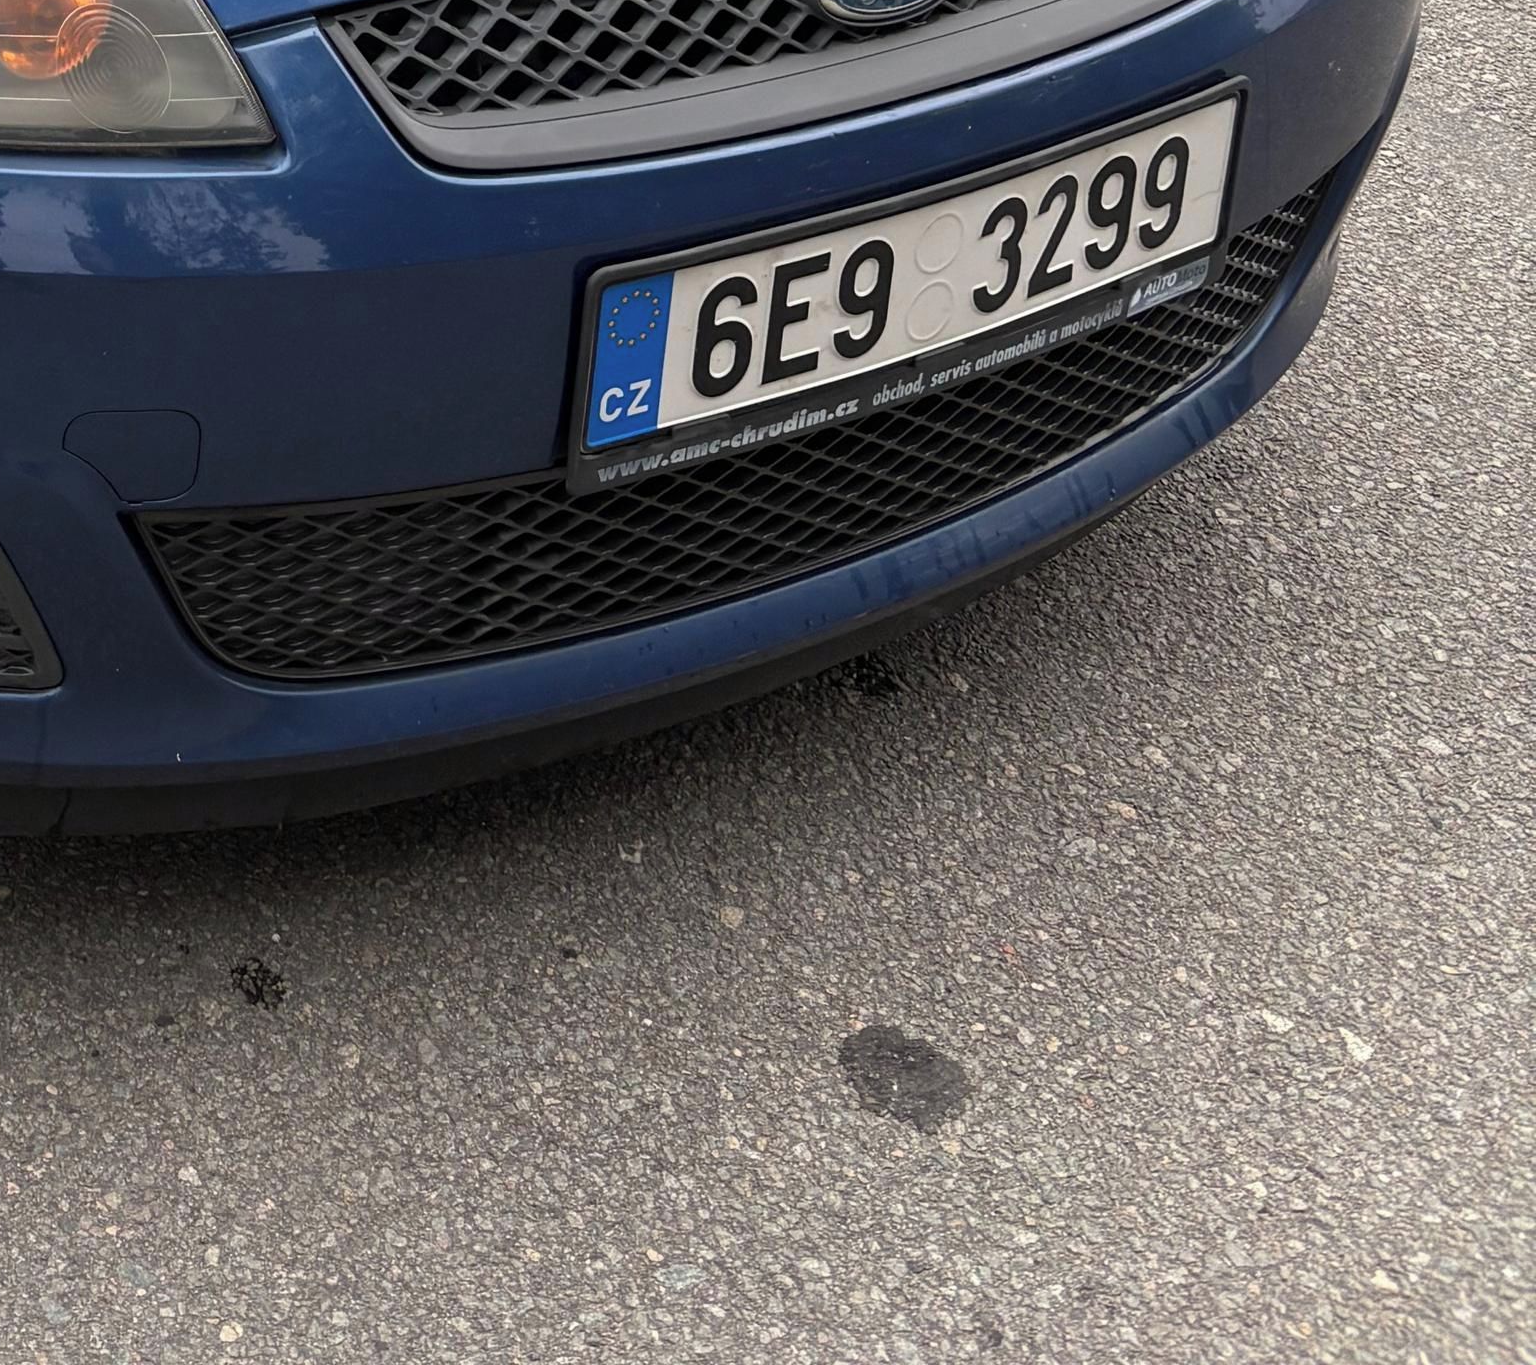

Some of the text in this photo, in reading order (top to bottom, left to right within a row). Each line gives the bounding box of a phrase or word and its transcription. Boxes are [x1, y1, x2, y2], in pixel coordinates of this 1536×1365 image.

[692, 135, 1190, 398] 6E9 3299
[597, 298, 1124, 483] www.amc-chrudim.cz obchod, servis automobilů a motocyklů
[599, 378, 652, 423] CZ
